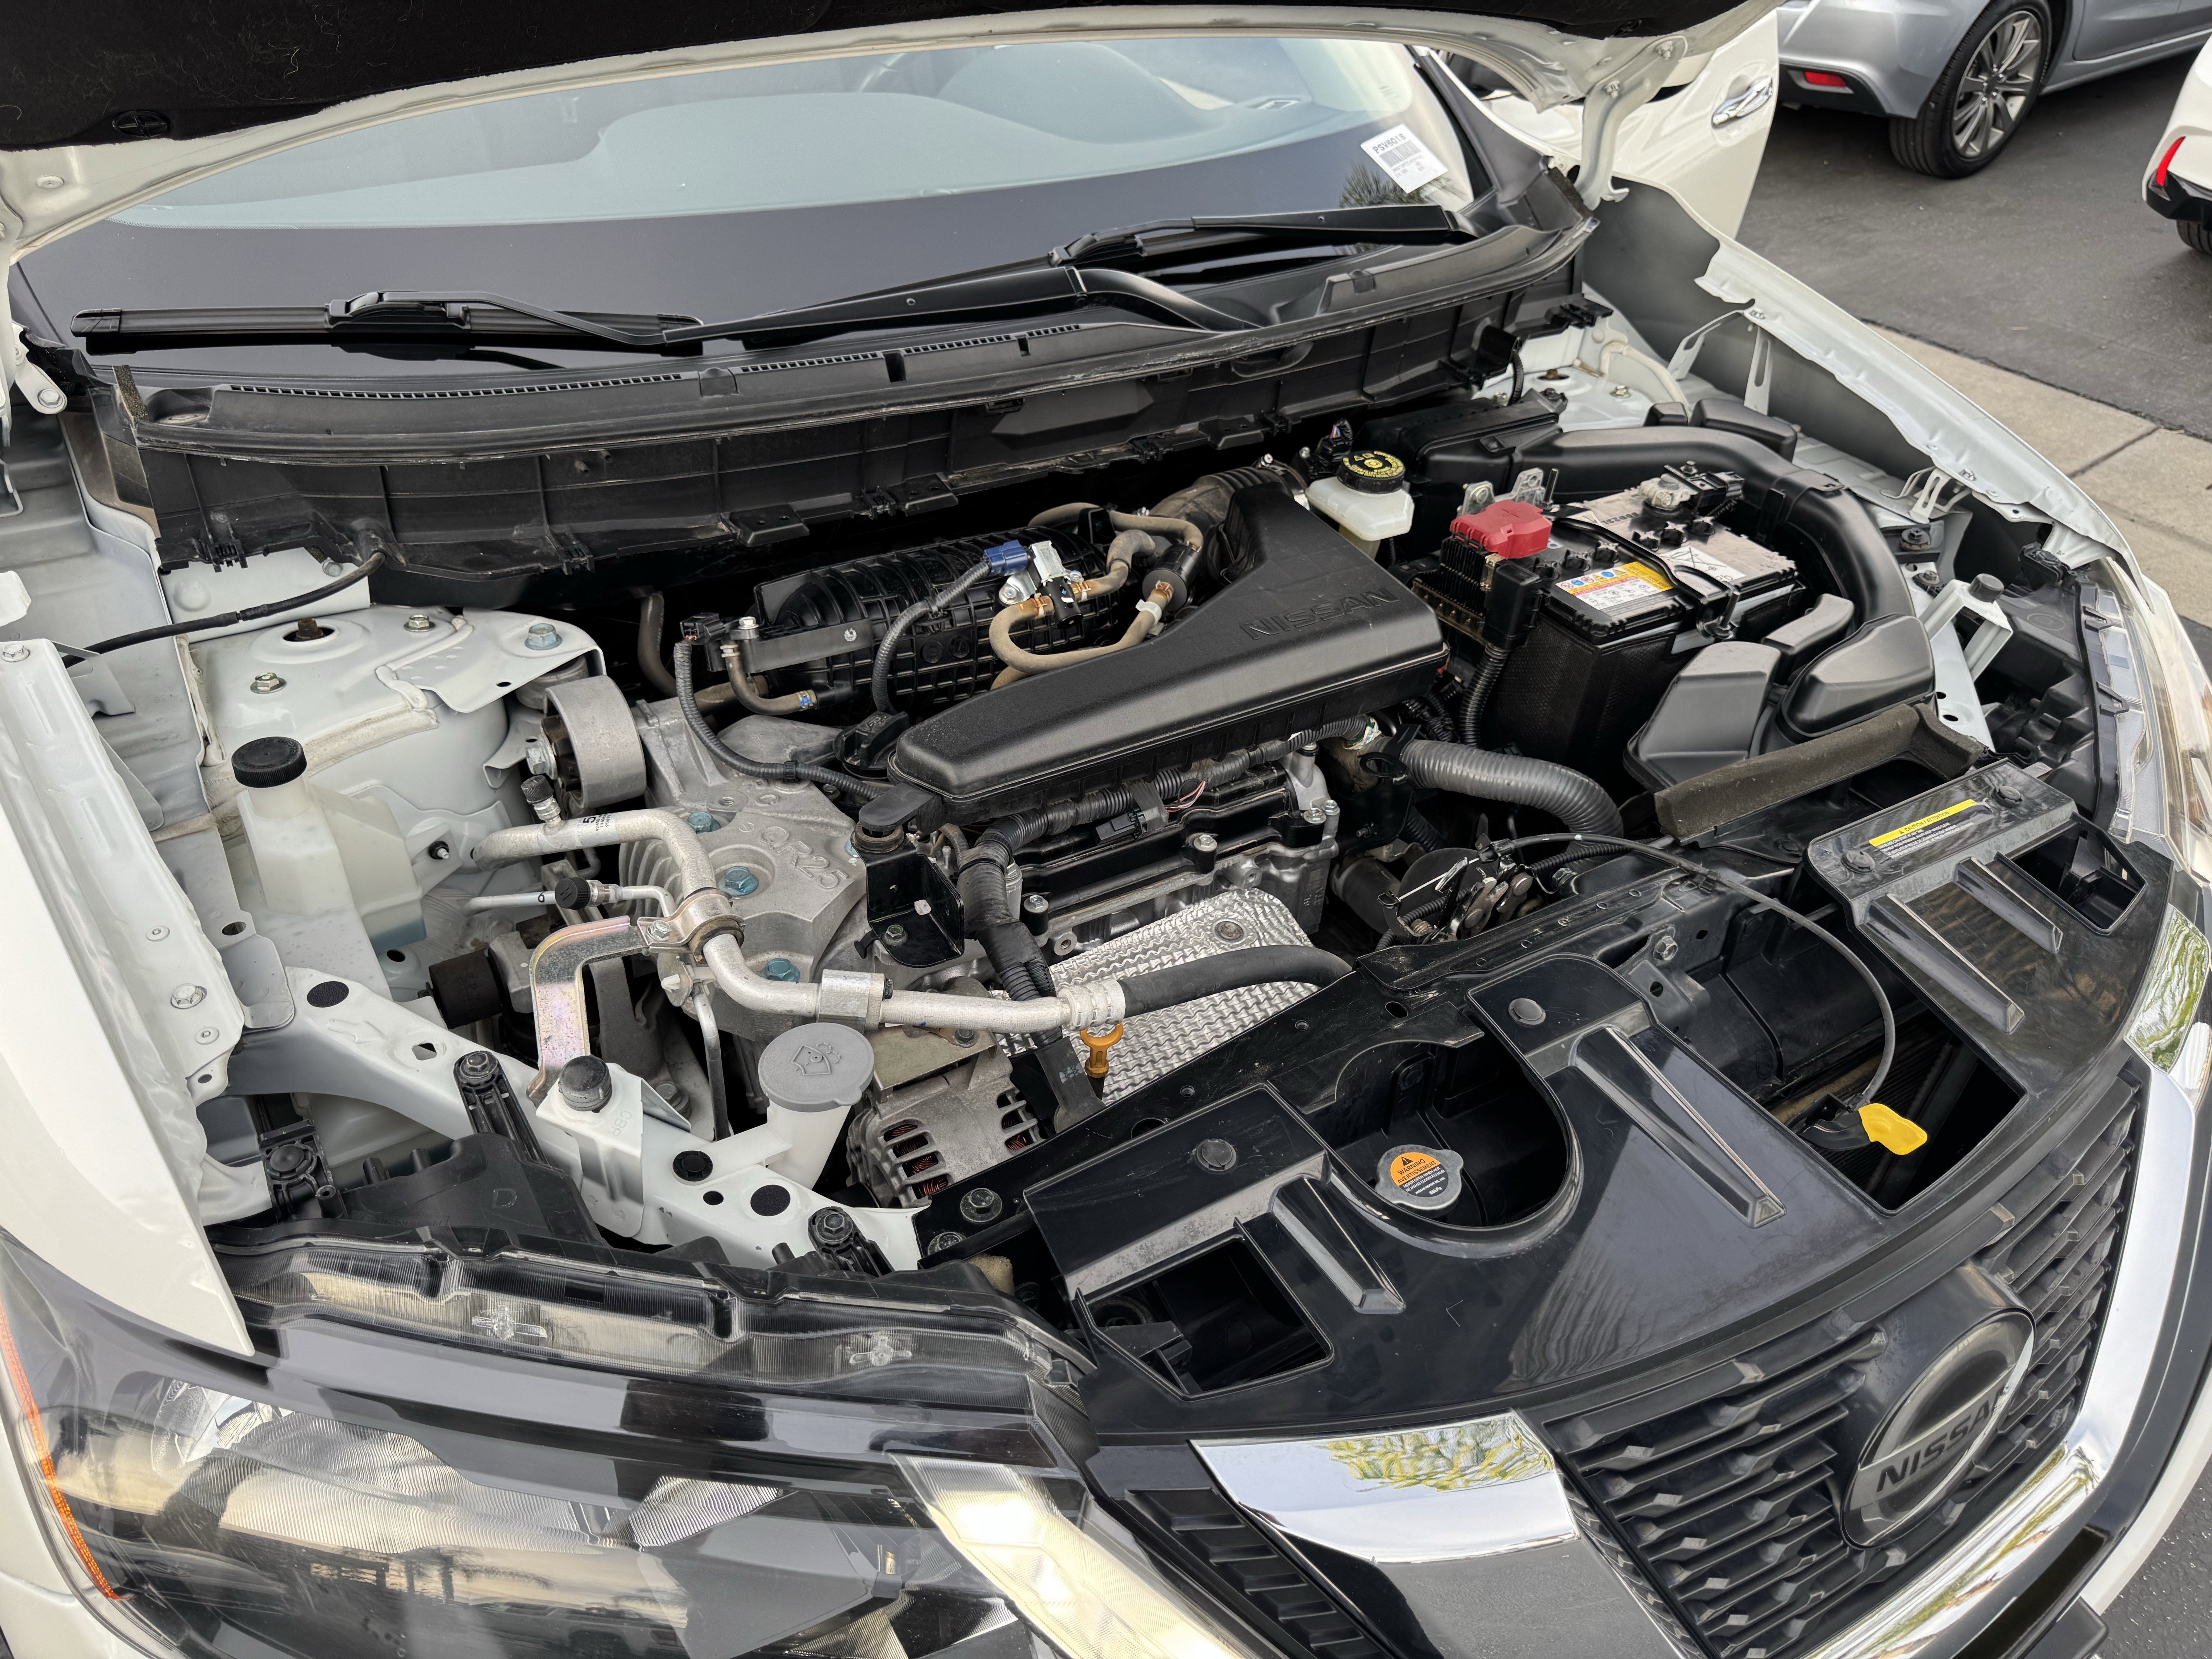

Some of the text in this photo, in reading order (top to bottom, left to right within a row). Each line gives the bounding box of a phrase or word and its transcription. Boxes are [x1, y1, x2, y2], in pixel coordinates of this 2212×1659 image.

[1240, 587, 1400, 640] NISSAN
[1904, 821, 1923, 832] CAUTION
[1926, 811, 1950, 823] ATTENTION
[760, 826, 849, 889] QR25
[538, 891, 545, 902] 6
[608, 1111, 632, 1137] CBR
[1397, 1159, 1426, 1175] WARNING
[1397, 1160, 1437, 1184] AVERTISSEMENT
[492, 1187, 517, 1209] D
